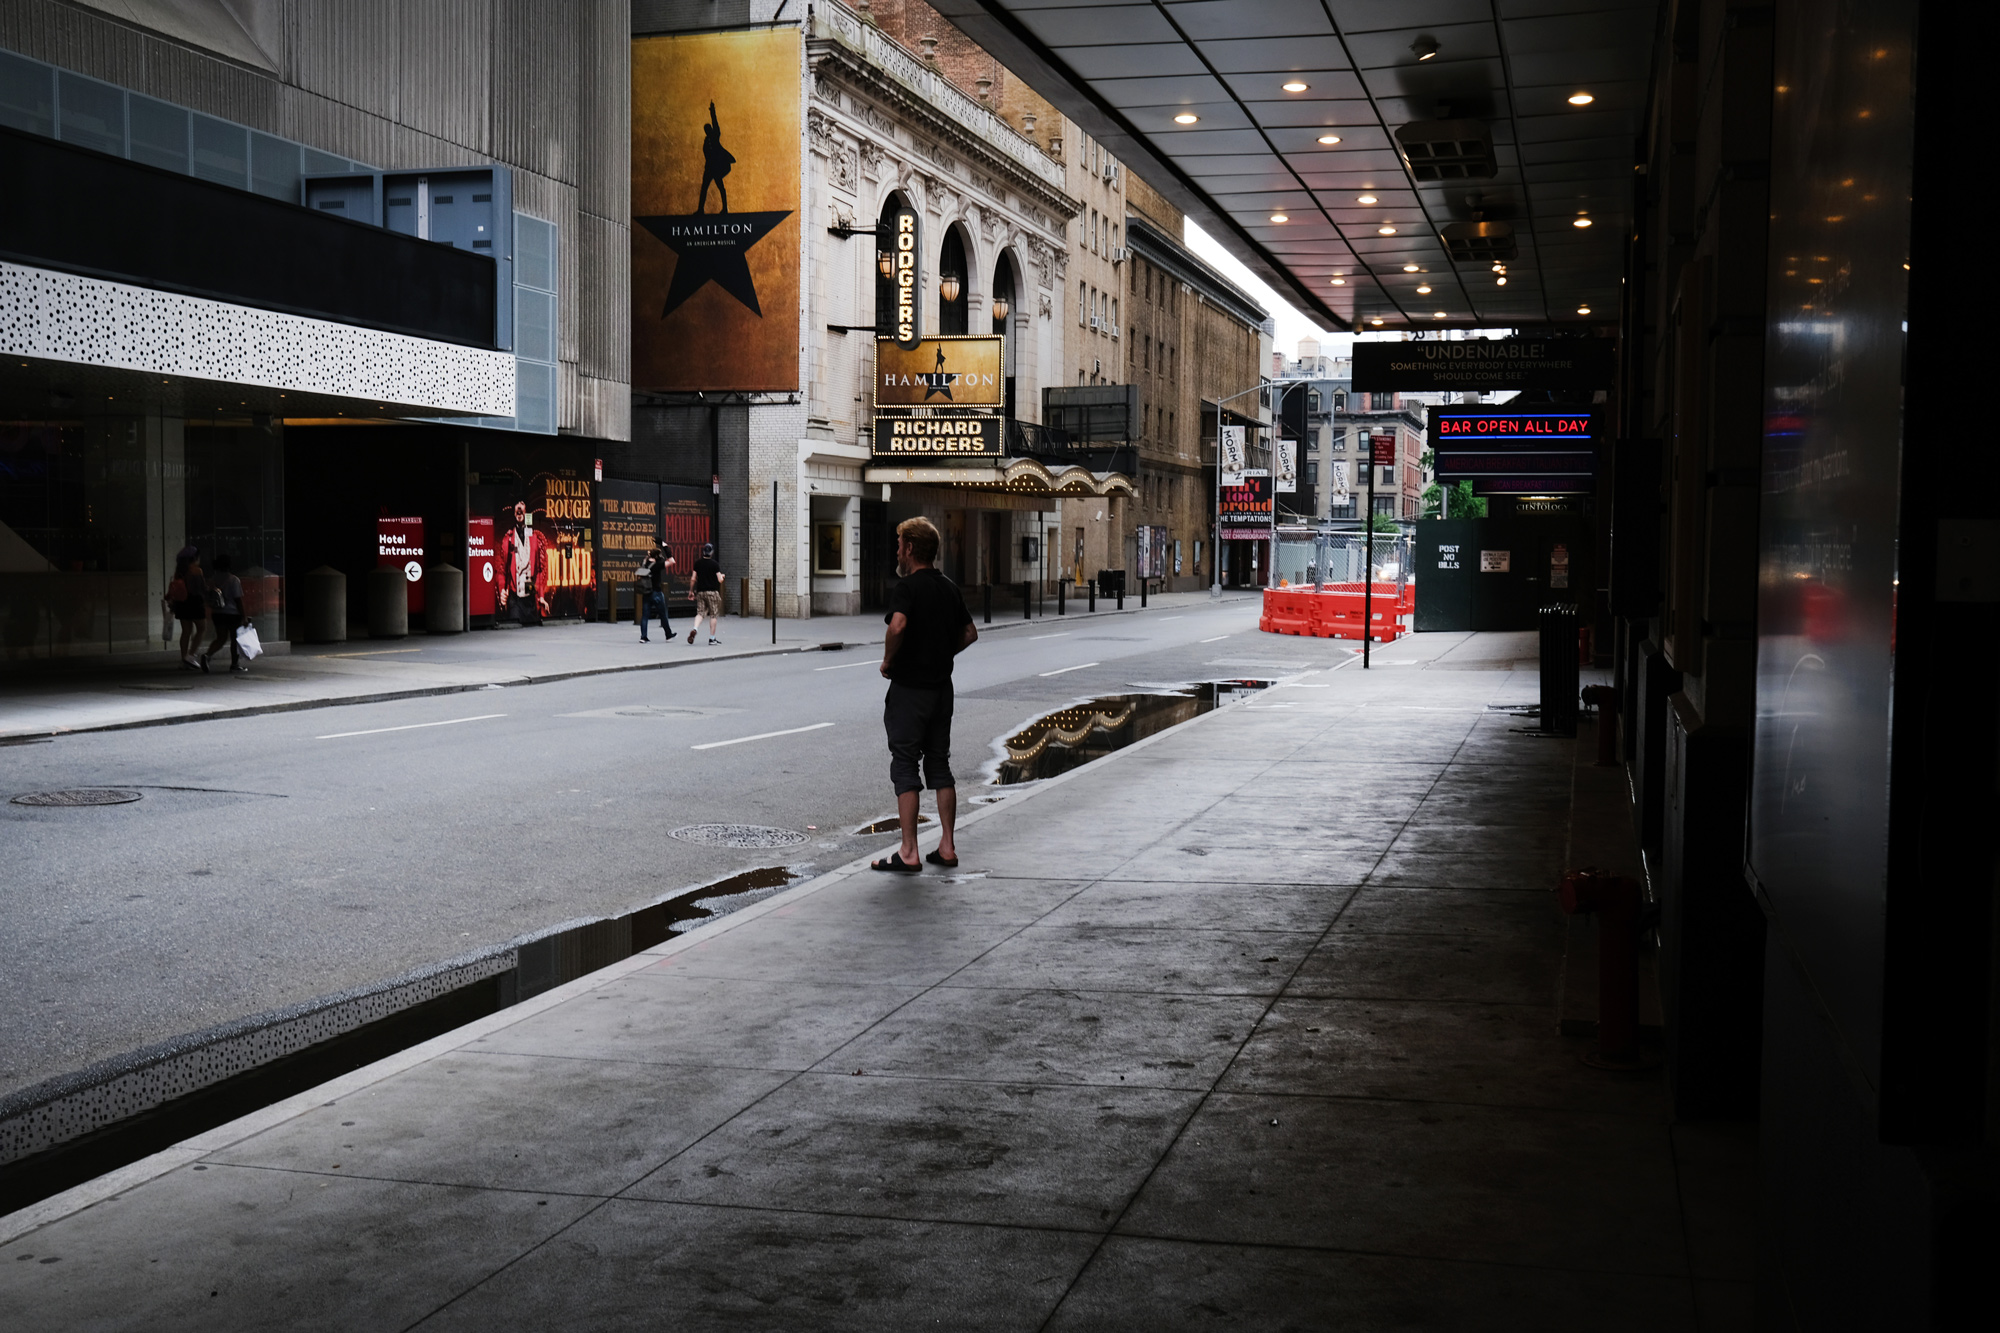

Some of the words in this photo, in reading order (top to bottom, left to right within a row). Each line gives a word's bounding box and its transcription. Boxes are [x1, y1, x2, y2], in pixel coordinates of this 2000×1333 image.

[672, 223, 752, 237] HAMILTON
[898, 215, 914, 342] RODGERS
[1390, 361, 1447, 371] SOMETHING
[1450, 361, 1505, 370] EVERYBODY
[1507, 360, 1572, 369] EVERYWHERE
[885, 372, 994, 387] HAMILTON
[1433, 372, 1473, 381] SHOULD
[1474, 371, 1503, 380] COME
[893, 421, 982, 435] RICHARD
[1440, 420, 1472, 433] BAR
[1476, 419, 1519, 433] OPEN
[1524, 419, 1553, 432] ALL
[1557, 418, 1588, 432] DAY
[890, 437, 985, 452] RODGERS
[546, 479, 591, 498] MOULIN
[545, 498, 591, 519] ROUGE
[621, 500, 656, 516] JUKEBOX
[1219, 498, 1272, 516] proud
[602, 521, 657, 533] EXPLODED!
[379, 534, 406, 544] Hotel
[468, 536, 484, 546] Hotel
[379, 545, 424, 556] Entrance
[468, 547, 494, 557] Entrance
[1438, 545, 1460, 553] POST
[1443, 553, 1455, 561] NO
[546, 548, 592, 587] MIND
[602, 560, 642, 568] EXTRAVAGA
[1437, 561, 1460, 570] BILLS
[602, 570, 638, 582] ENTERTAI
